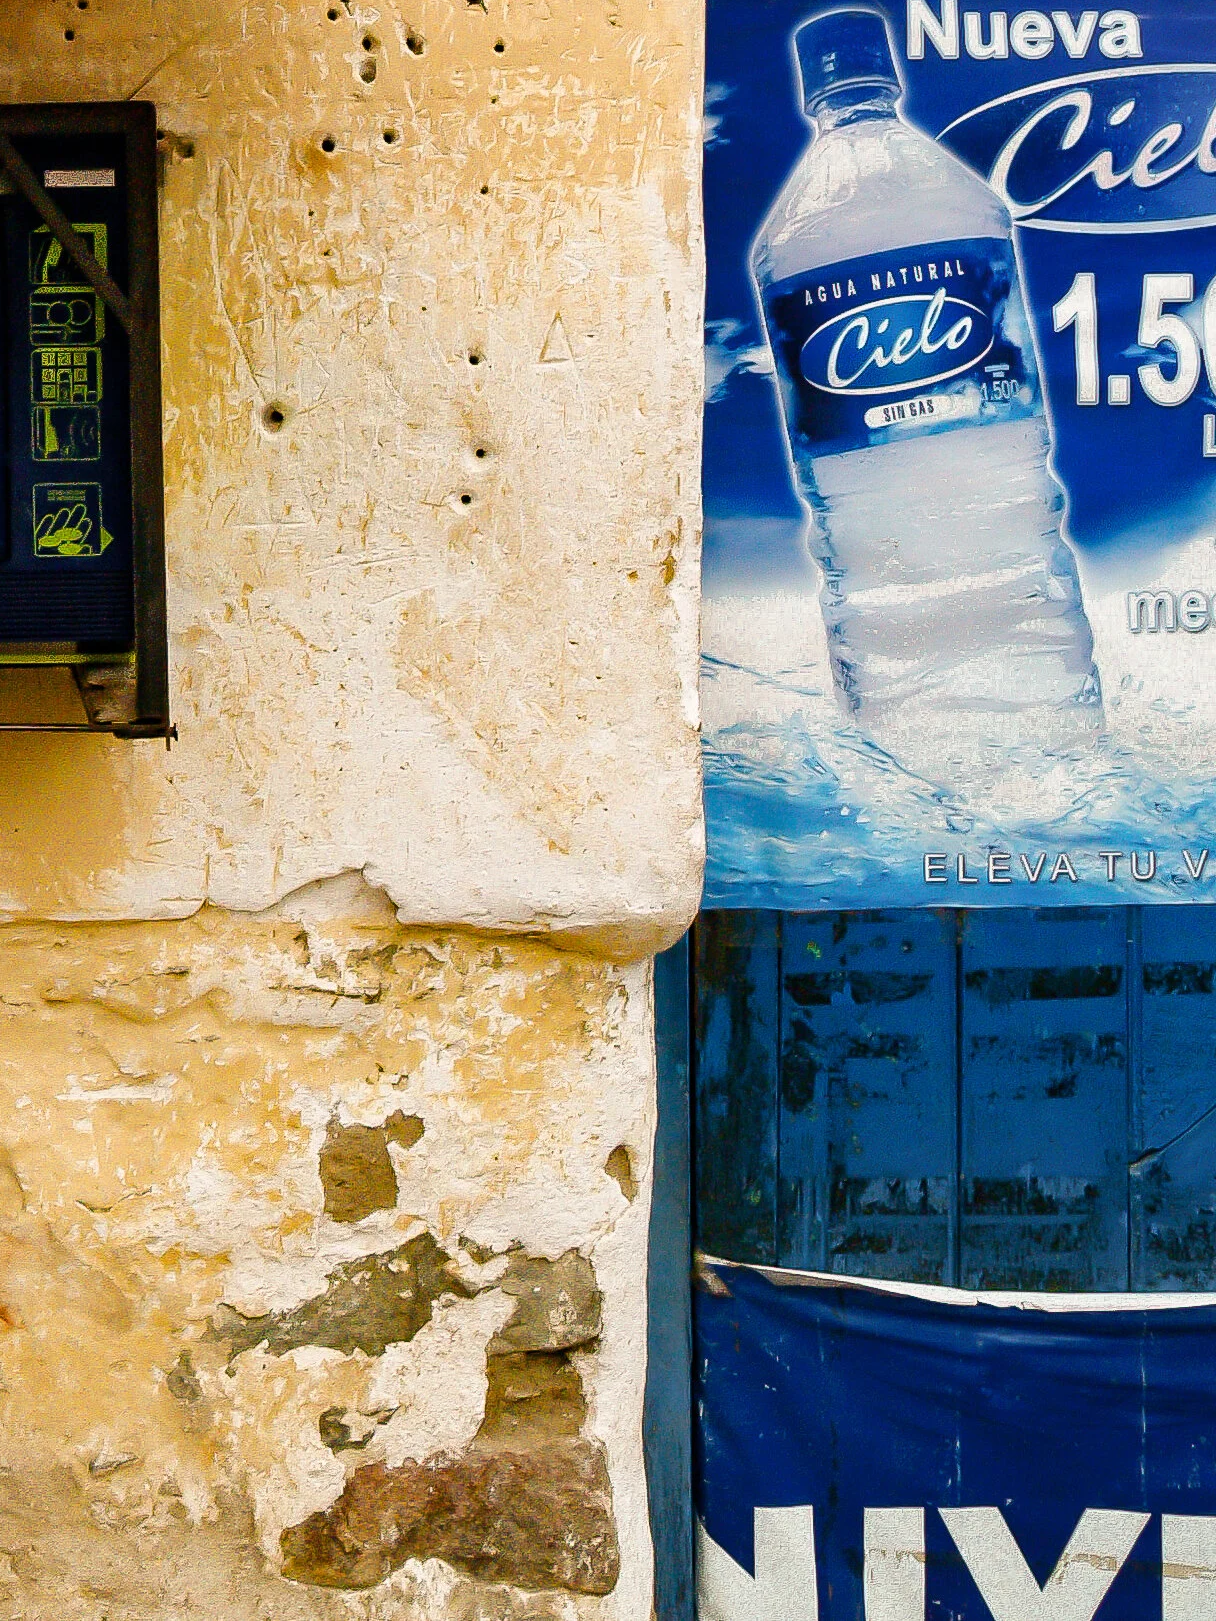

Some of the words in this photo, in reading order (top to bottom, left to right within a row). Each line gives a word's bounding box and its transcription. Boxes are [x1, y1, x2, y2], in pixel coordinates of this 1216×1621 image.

[805, 279, 857, 306] AGUA
[871, 260, 965, 290] NATURAL
[827, 286, 973, 388] Cielo
[1052, 272, 1216, 407] 1.5
[883, 405, 905, 422] SIN
[909, 399, 934, 417] GAS
[1127, 589, 1216, 634] me
[923, 852, 1079, 883] ELEVA
[1099, 850, 1156, 881] TU
